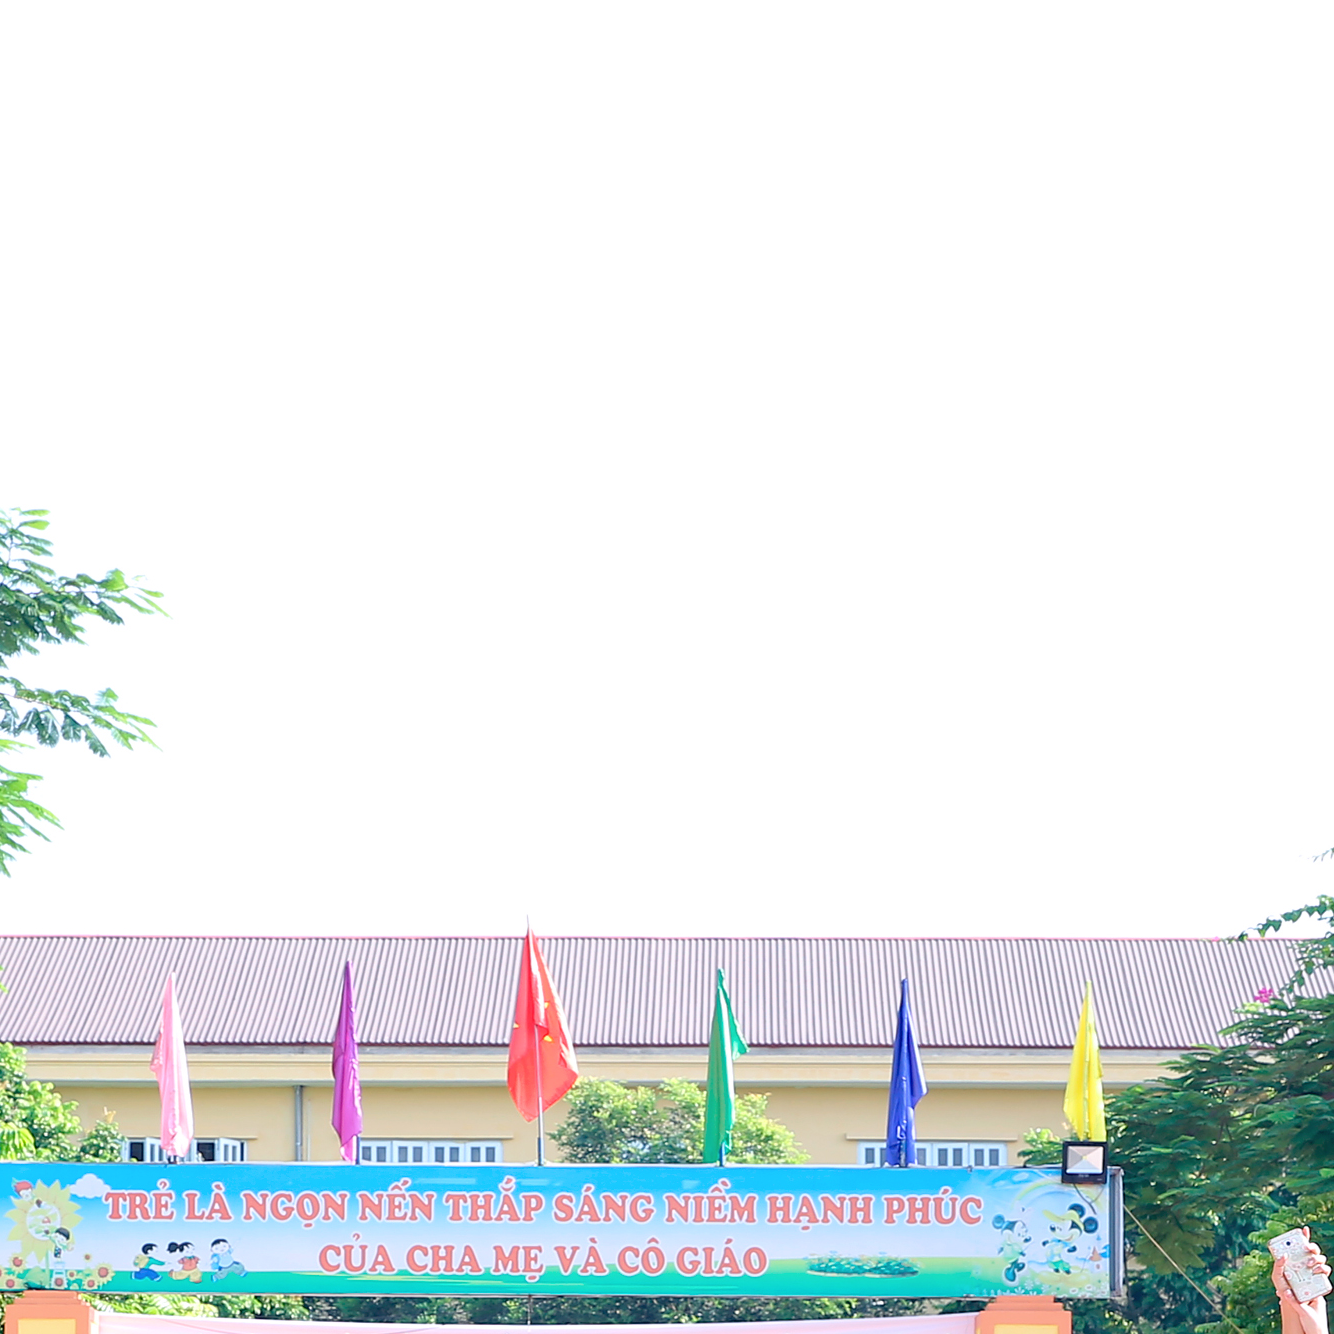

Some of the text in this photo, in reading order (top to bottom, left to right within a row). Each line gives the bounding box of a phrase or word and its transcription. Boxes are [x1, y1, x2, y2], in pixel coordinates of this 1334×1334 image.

[104, 1177, 983, 1231] TRẺ LÀ NGỌN NẾN THẮP SÁNG NIỀM HẠNH PHÚC
[318, 1232, 768, 1281] CỦA CHA MẸ VÀ CÔ GIÁO
